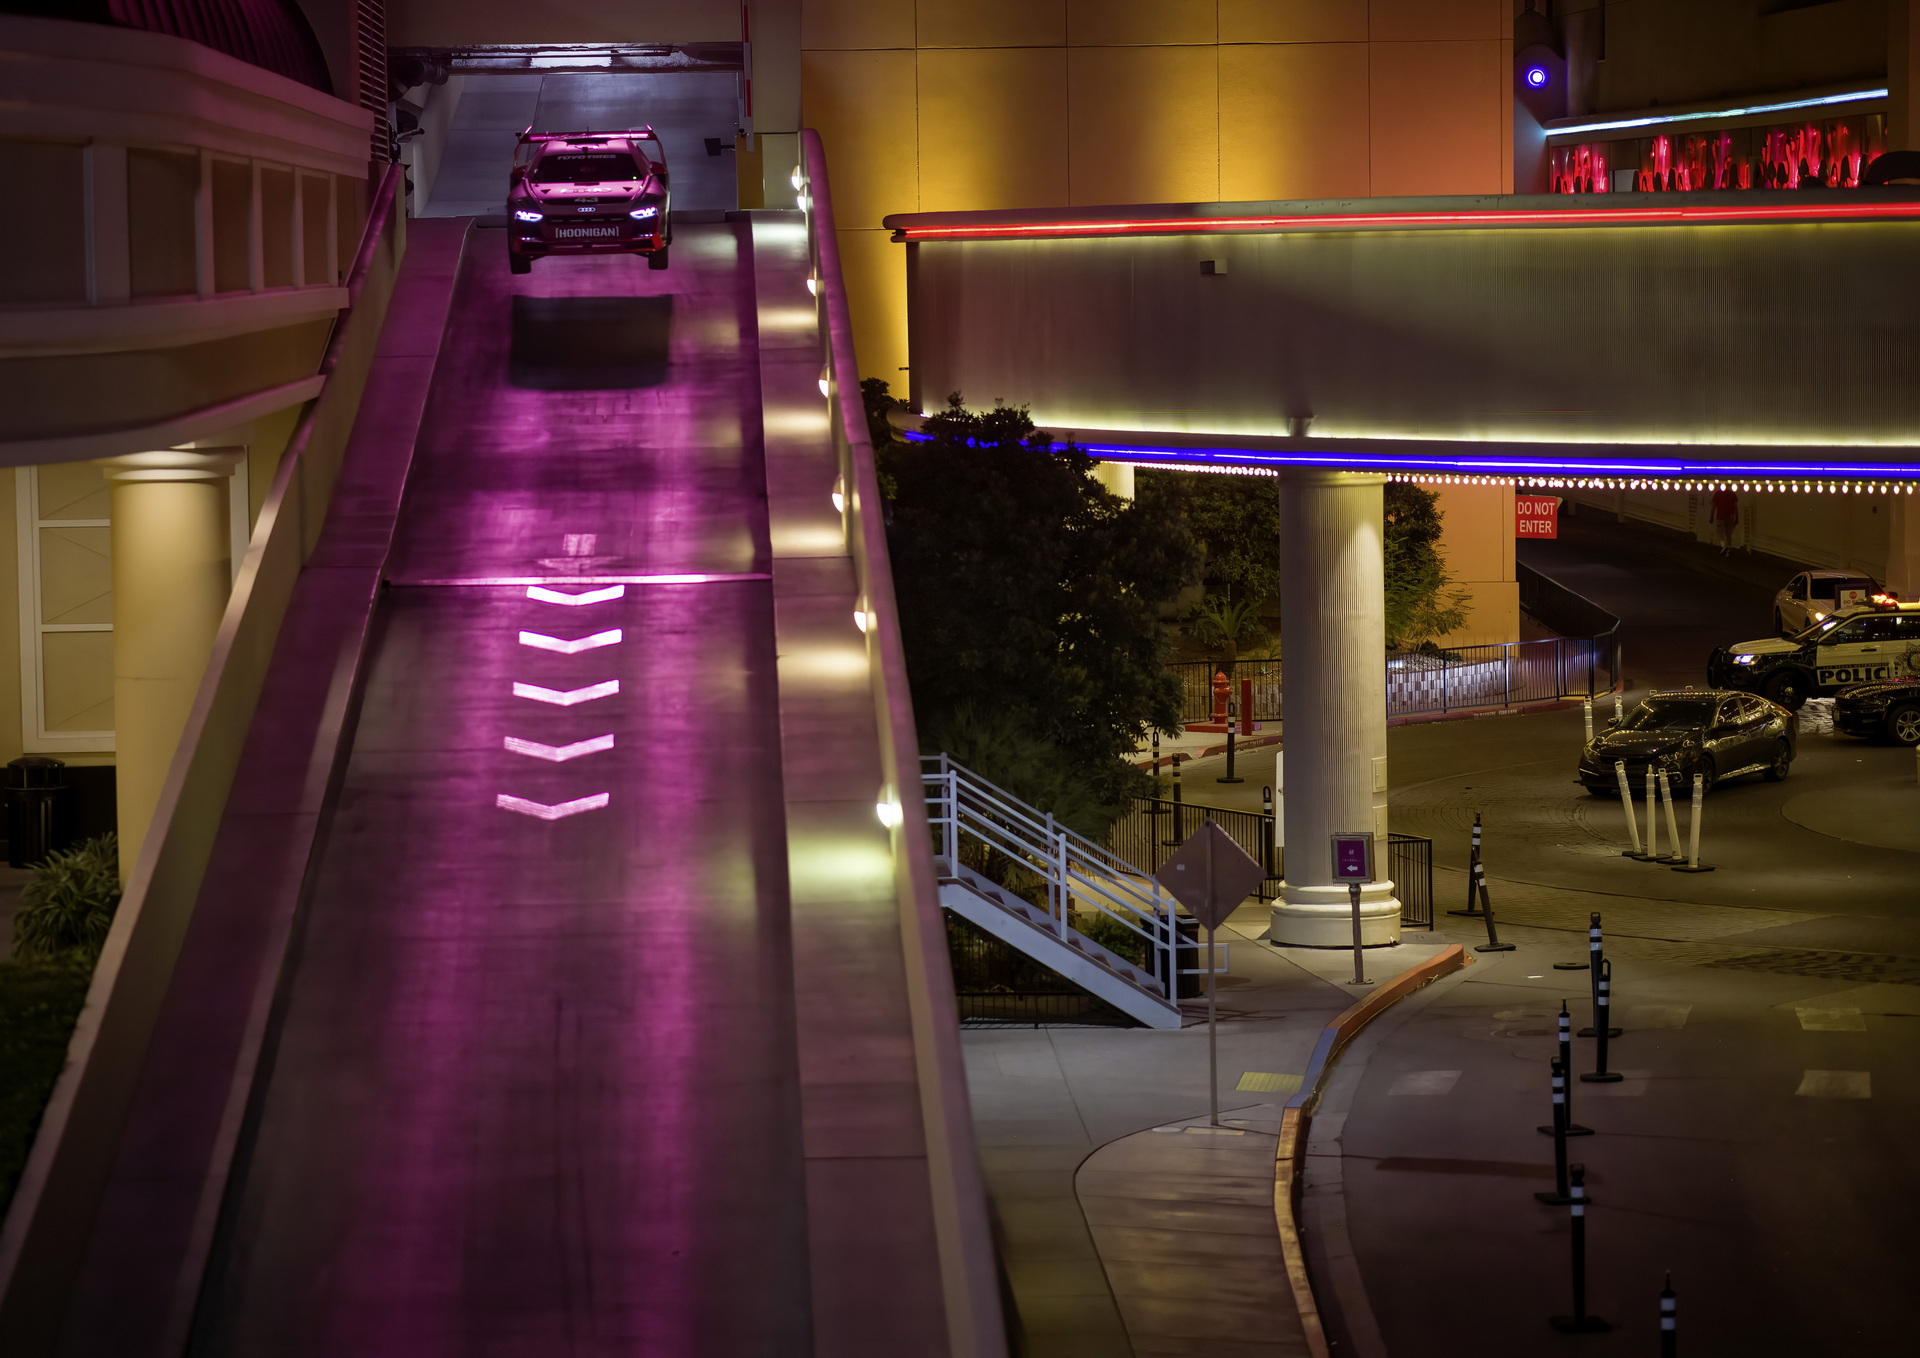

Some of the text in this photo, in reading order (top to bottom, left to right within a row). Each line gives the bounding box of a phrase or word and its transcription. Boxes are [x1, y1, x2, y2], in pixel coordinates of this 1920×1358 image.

[1517, 502, 1555, 515] DO NOT
[1519, 520, 1552, 533] ENTER
